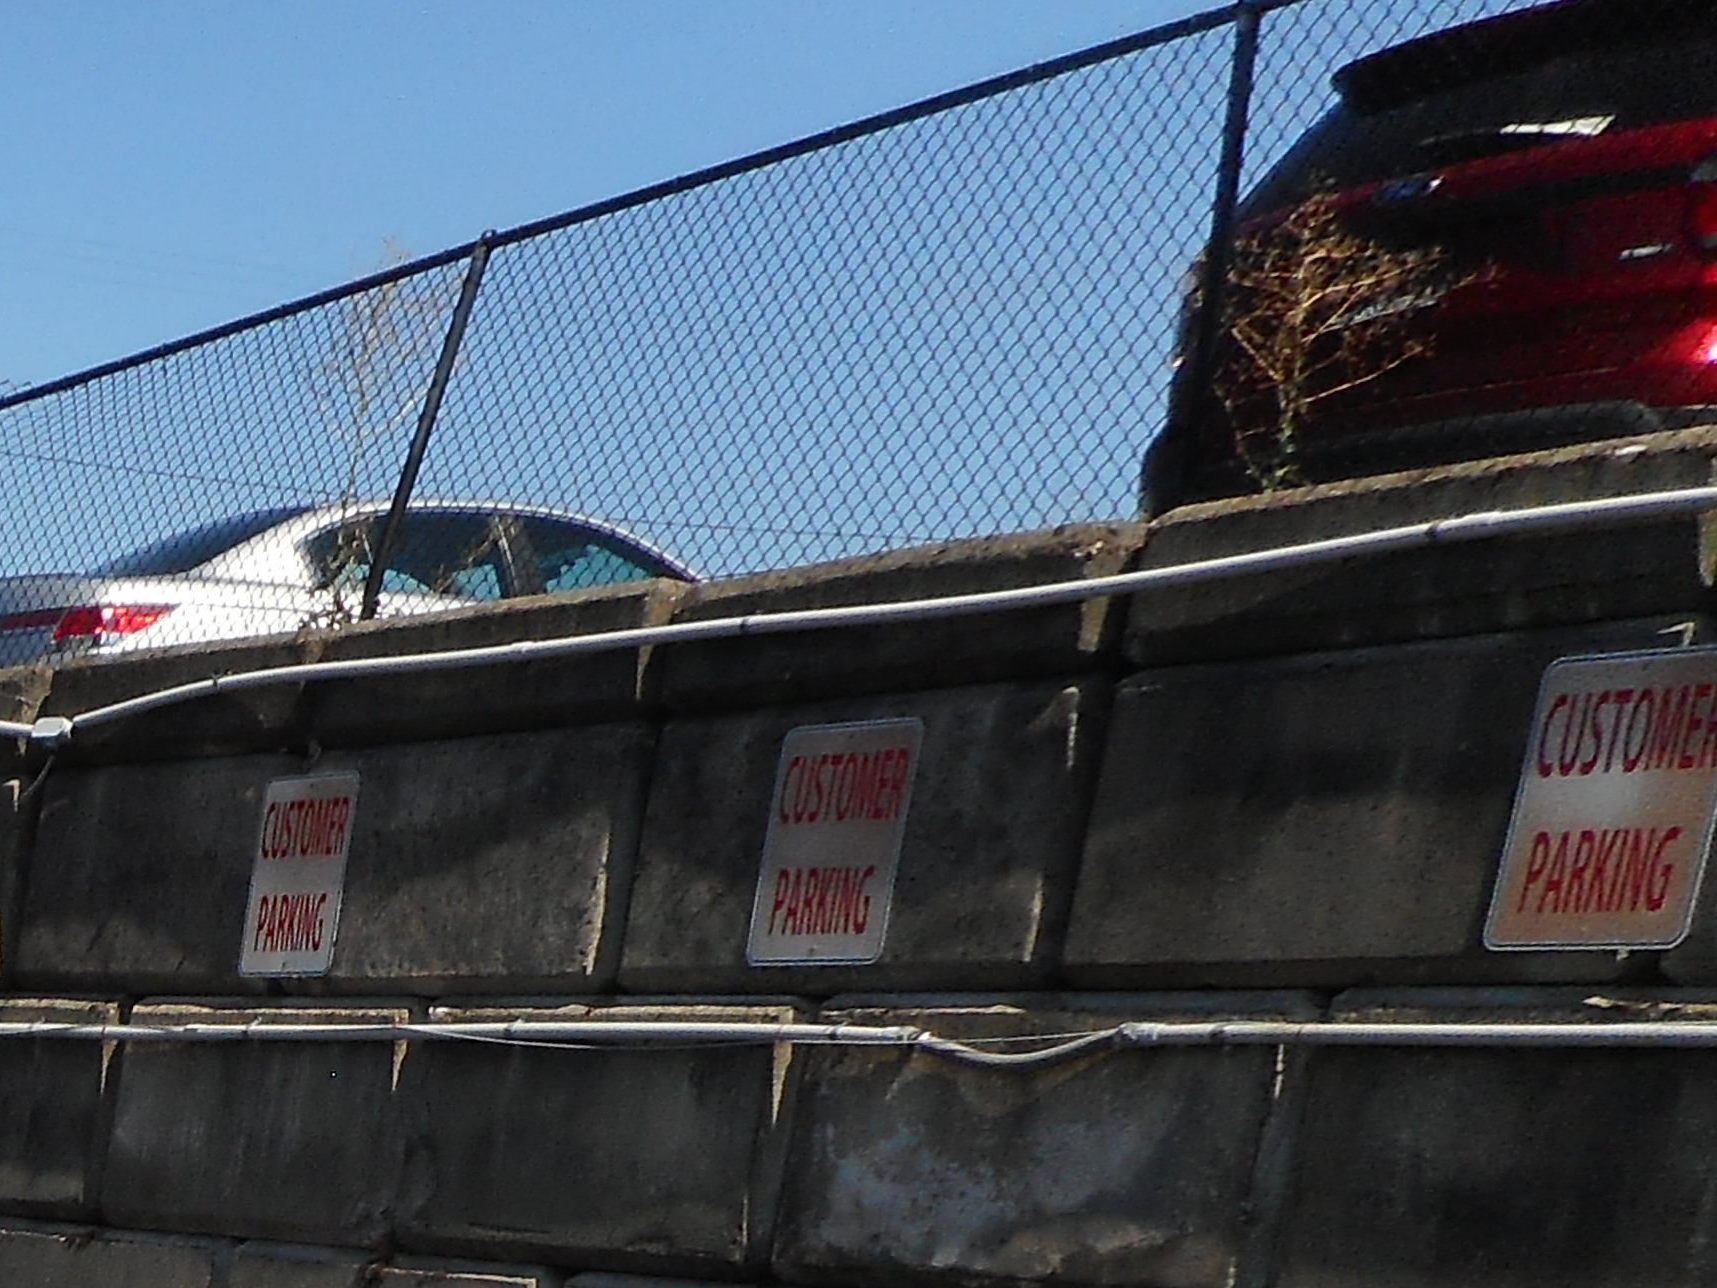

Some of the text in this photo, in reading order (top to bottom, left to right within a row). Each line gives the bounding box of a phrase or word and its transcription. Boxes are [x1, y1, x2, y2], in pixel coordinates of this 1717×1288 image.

[1537, 683, 1717, 778] CUSTOMER
[780, 748, 911, 824] CUSTOMER
[262, 797, 351, 859] CUSTOMER
[768, 865, 875, 936] PARKING
[1519, 826, 1683, 913] PARKING
[254, 893, 327, 952] PARKING
